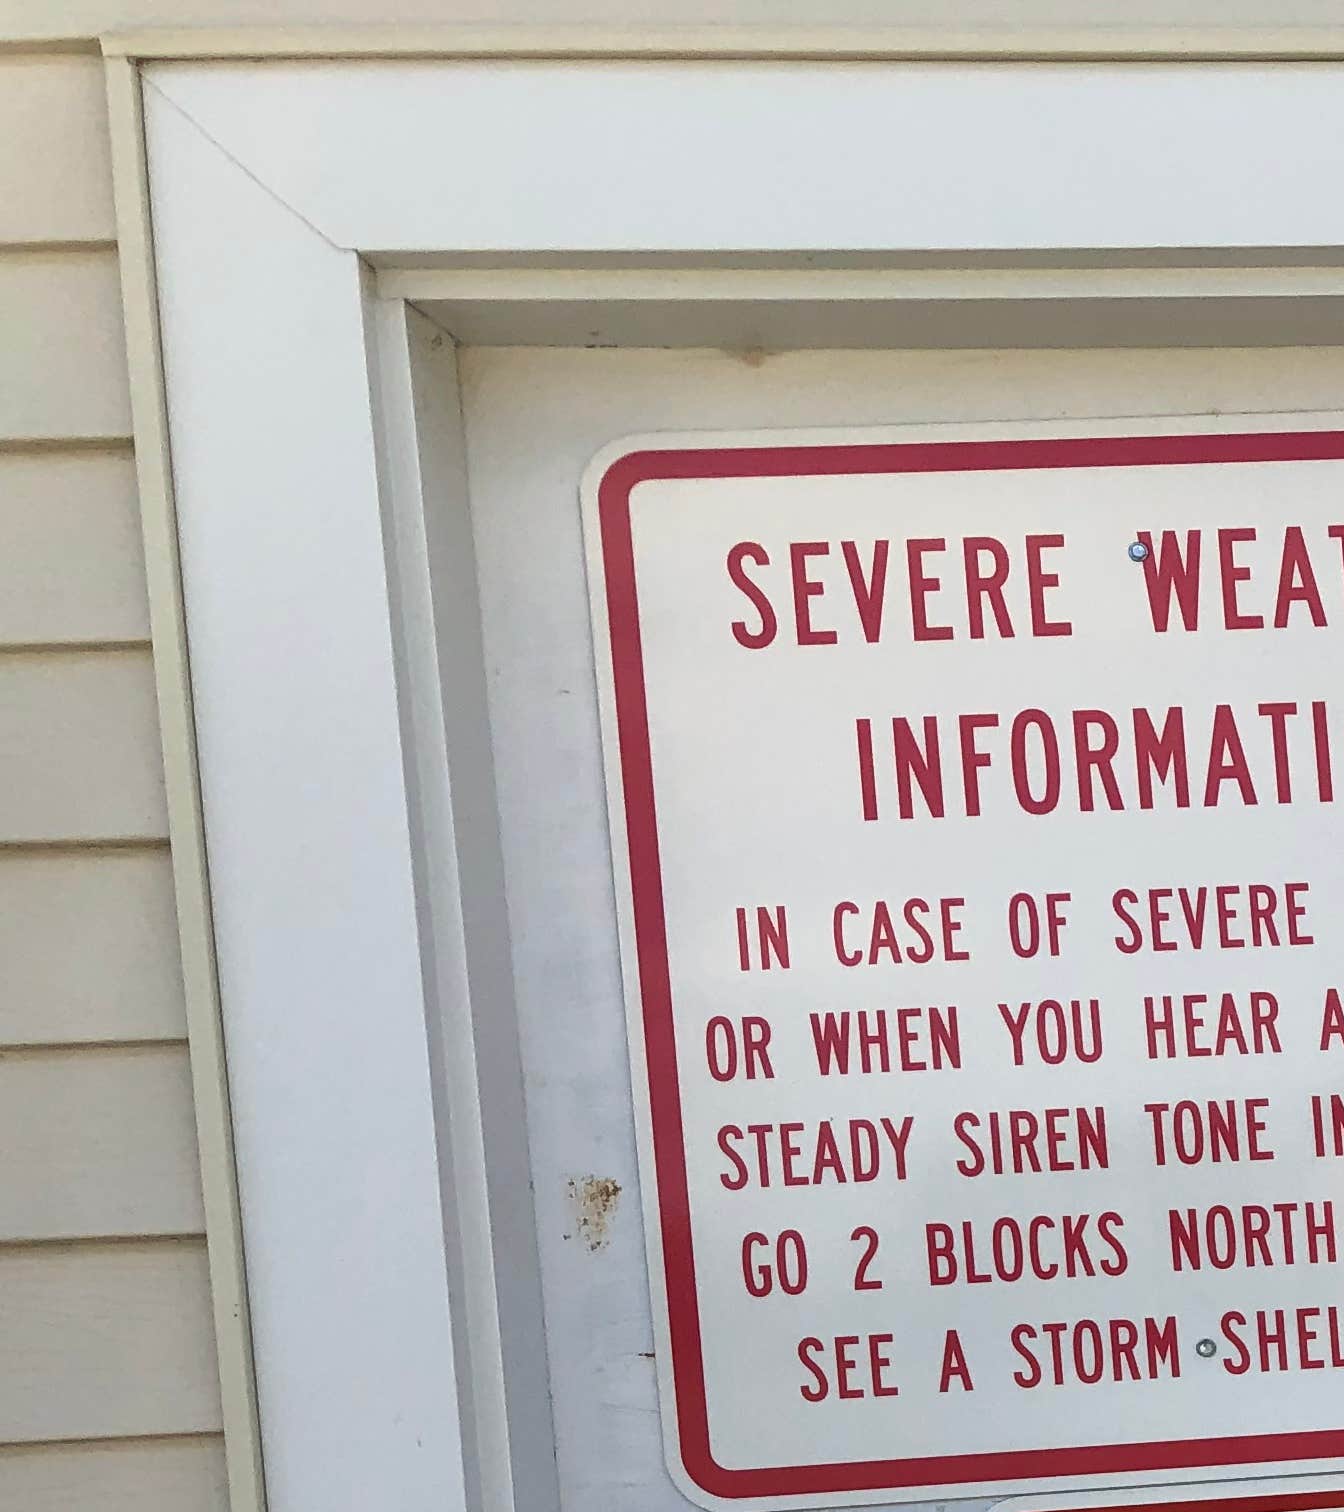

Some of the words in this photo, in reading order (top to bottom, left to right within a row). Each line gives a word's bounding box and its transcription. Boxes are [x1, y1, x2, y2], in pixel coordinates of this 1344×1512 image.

[728, 536, 1071, 648] SEVERE
[737, 908, 789, 969] IN
[834, 899, 968, 966] CASE
[1010, 894, 1069, 957] OF
[1113, 884, 1312, 953] SEVERE
[707, 1017, 772, 1080] OR
[812, 1008, 959, 1074] WHEN
[999, 1001, 1101, 1064] YOU
[1145, 993, 1280, 1057] HEAR
[718, 1113, 912, 1189] STEADY
[955, 1109, 1106, 1176] SIREN
[1146, 1100, 1272, 1164] TONE
[743, 1231, 806, 1296] GO
[853, 1228, 881, 1289] 2
[927, 1212, 1126, 1284] BLOCKS
[1170, 1203, 1335, 1270] NORTH
[800, 1335, 896, 1401] SEE
[941, 1332, 972, 1391] A
[1012, 1318, 1179, 1386] STORM
